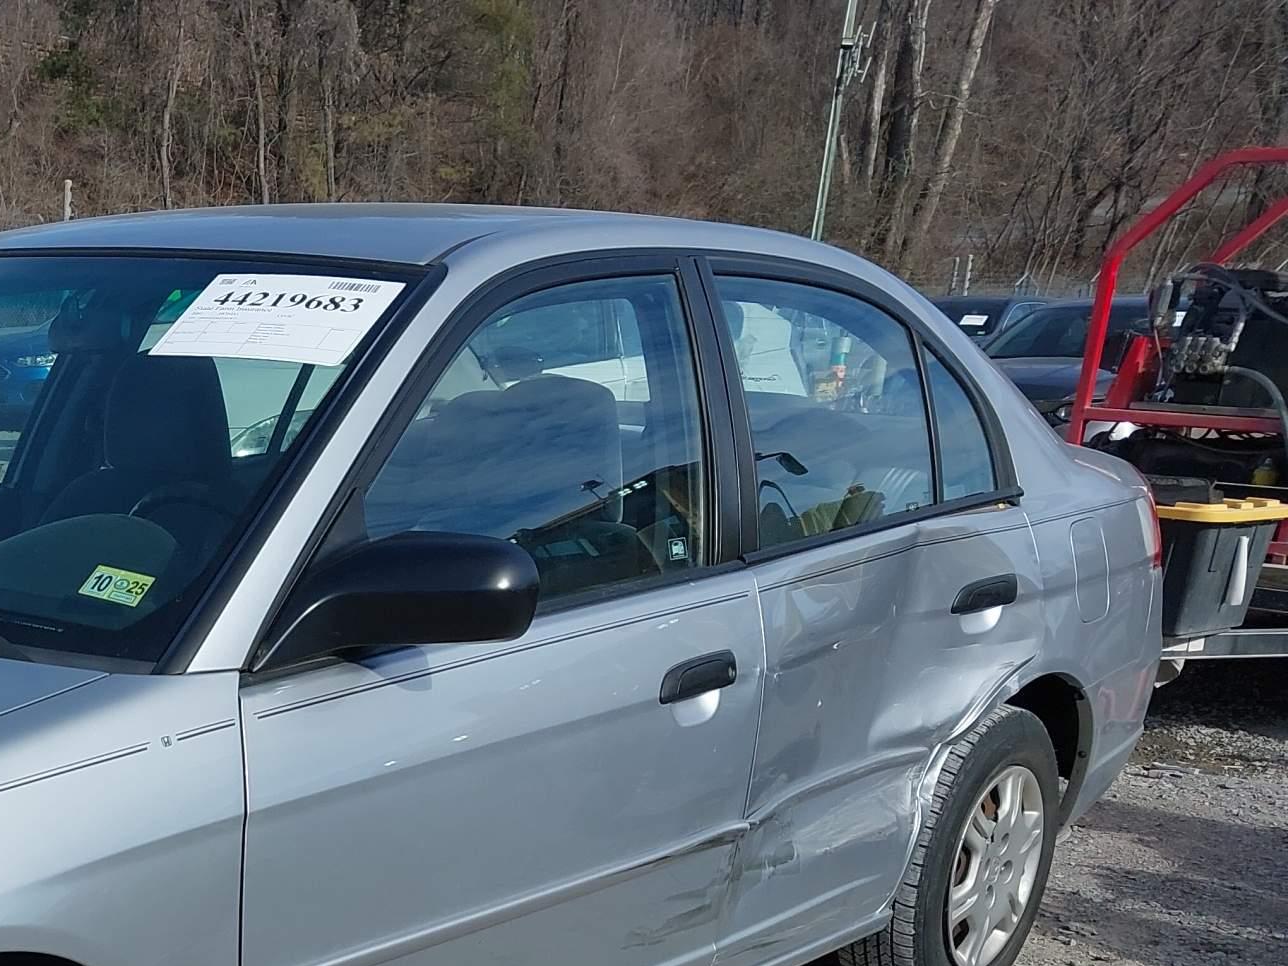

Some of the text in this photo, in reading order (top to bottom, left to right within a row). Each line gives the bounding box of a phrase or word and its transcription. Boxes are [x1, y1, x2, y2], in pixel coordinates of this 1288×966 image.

[214, 291, 364, 313] 44219683
[90, 573, 149, 596] 10 25
